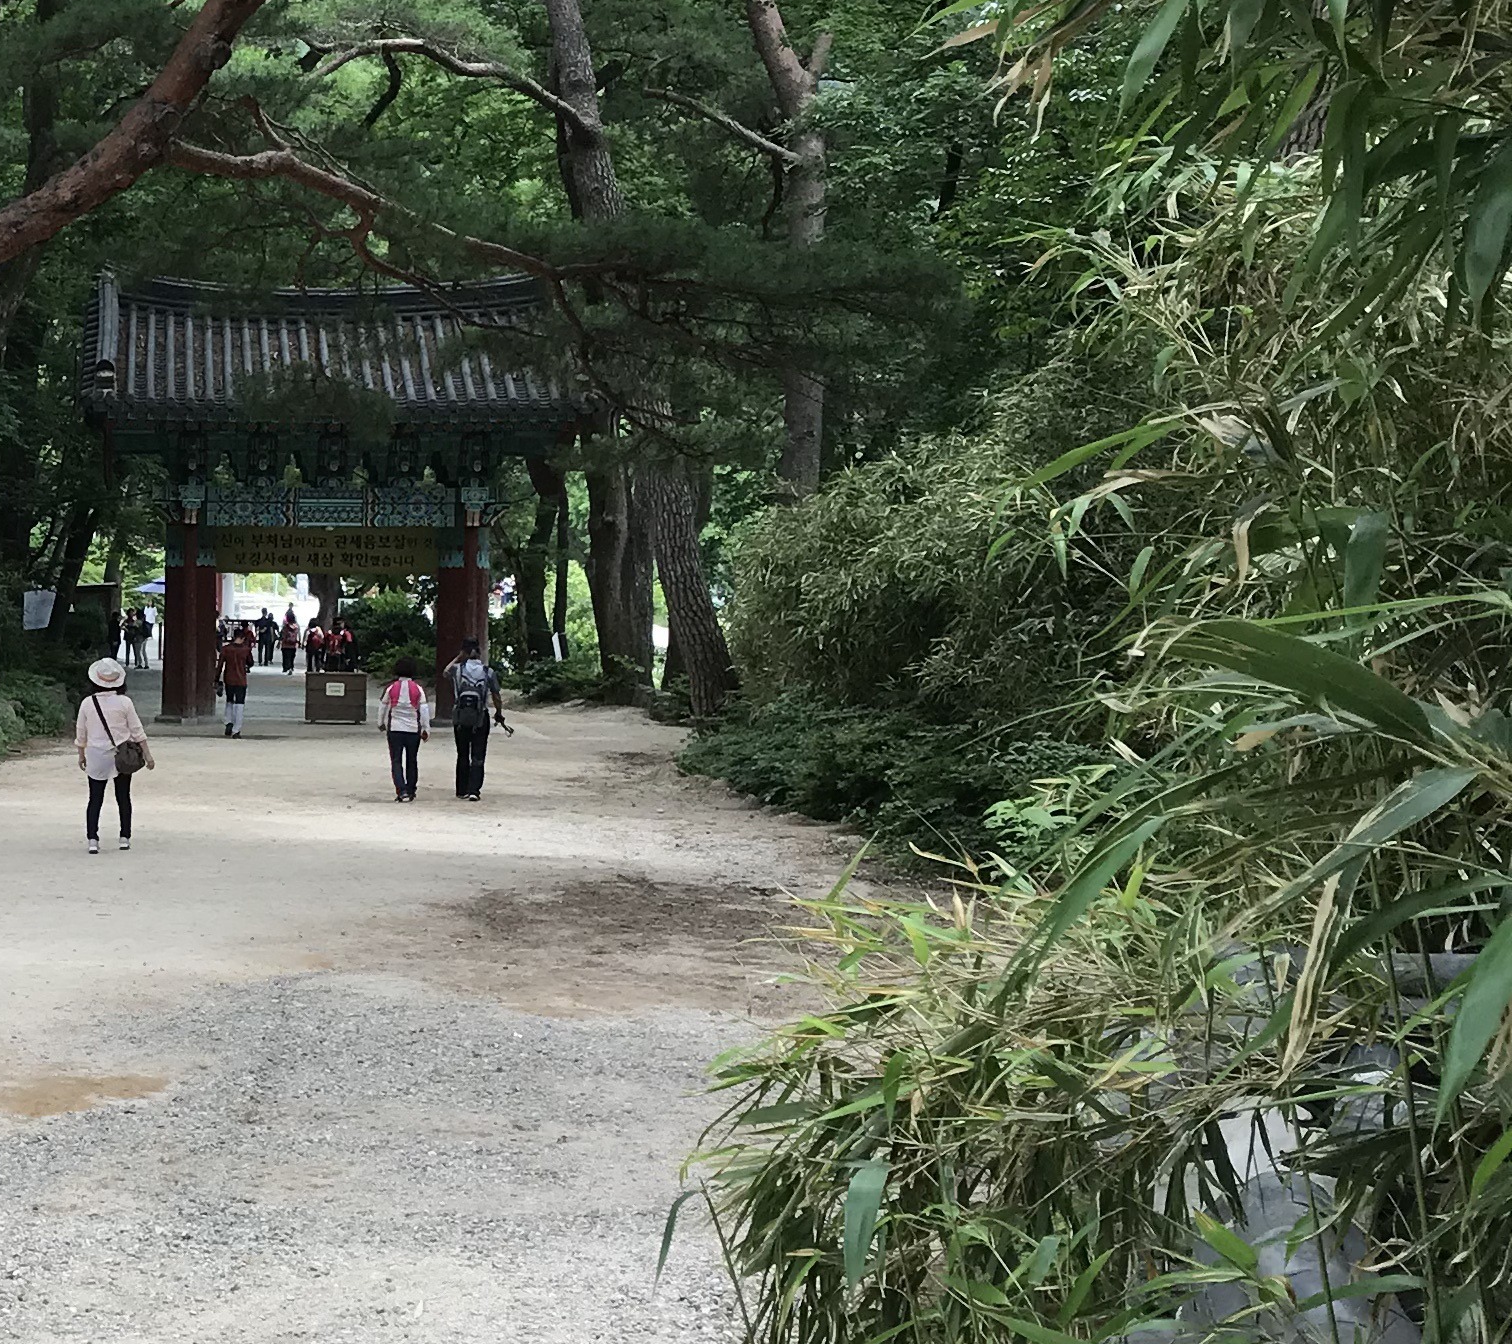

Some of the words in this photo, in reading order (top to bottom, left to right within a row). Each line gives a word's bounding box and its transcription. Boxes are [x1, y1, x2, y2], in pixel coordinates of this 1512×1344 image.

[251, 532, 328, 549] 부처님이시고
[233, 551, 301, 567] 보경사에서
[339, 552, 416, 568] 확인했습니다
